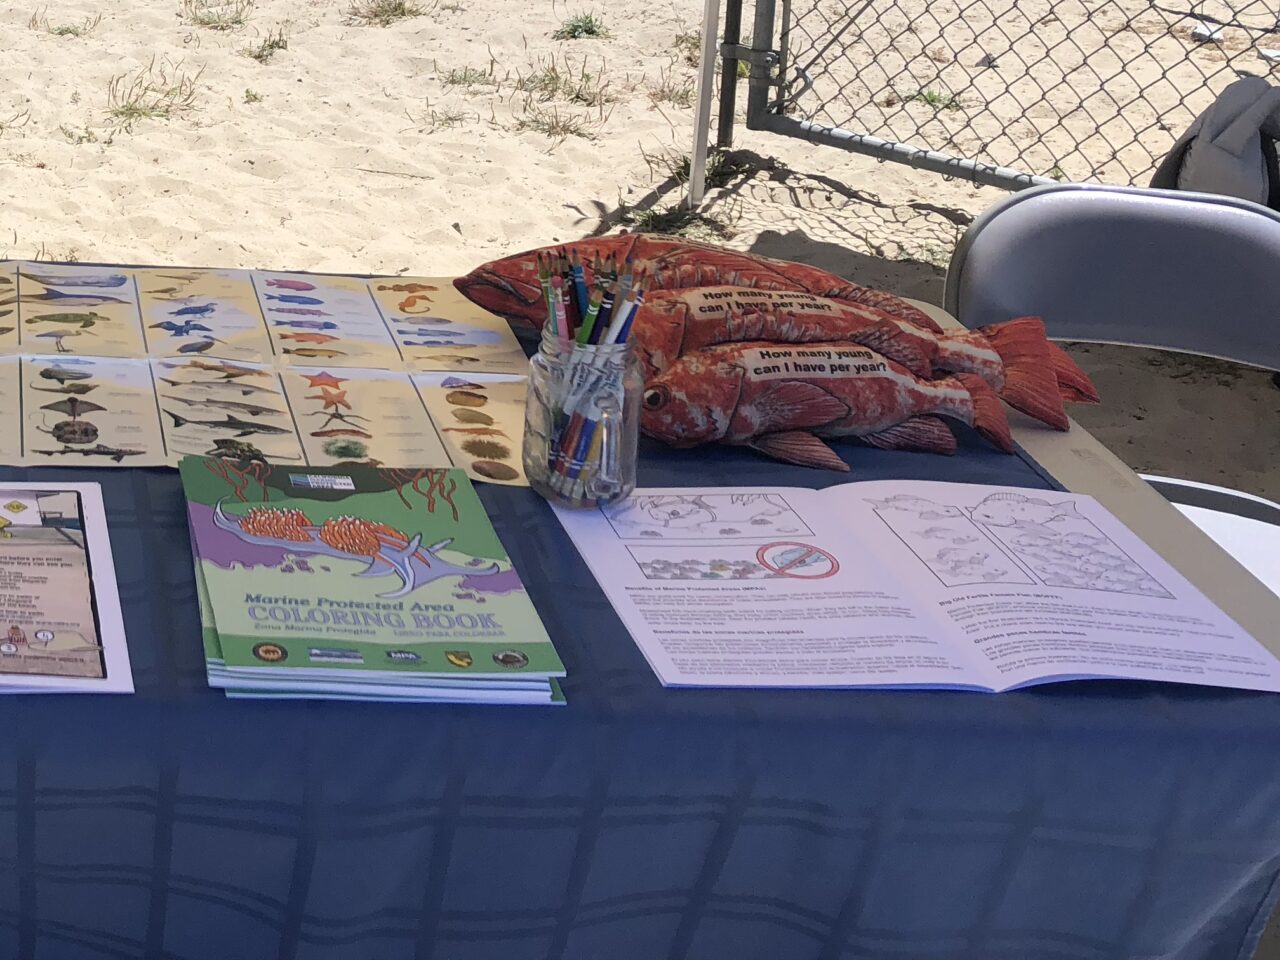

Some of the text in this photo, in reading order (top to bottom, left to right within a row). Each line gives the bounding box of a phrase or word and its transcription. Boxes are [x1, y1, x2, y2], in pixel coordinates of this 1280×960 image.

[702, 290, 816, 302] How many young
[699, 300, 832, 313] can I have per year?
[759, 350, 873, 360] How many young
[753, 362, 886, 375] can I have per year?
[244, 593, 455, 612] Marine Protected Area
[248, 605, 503, 629] COLORING BOOK
